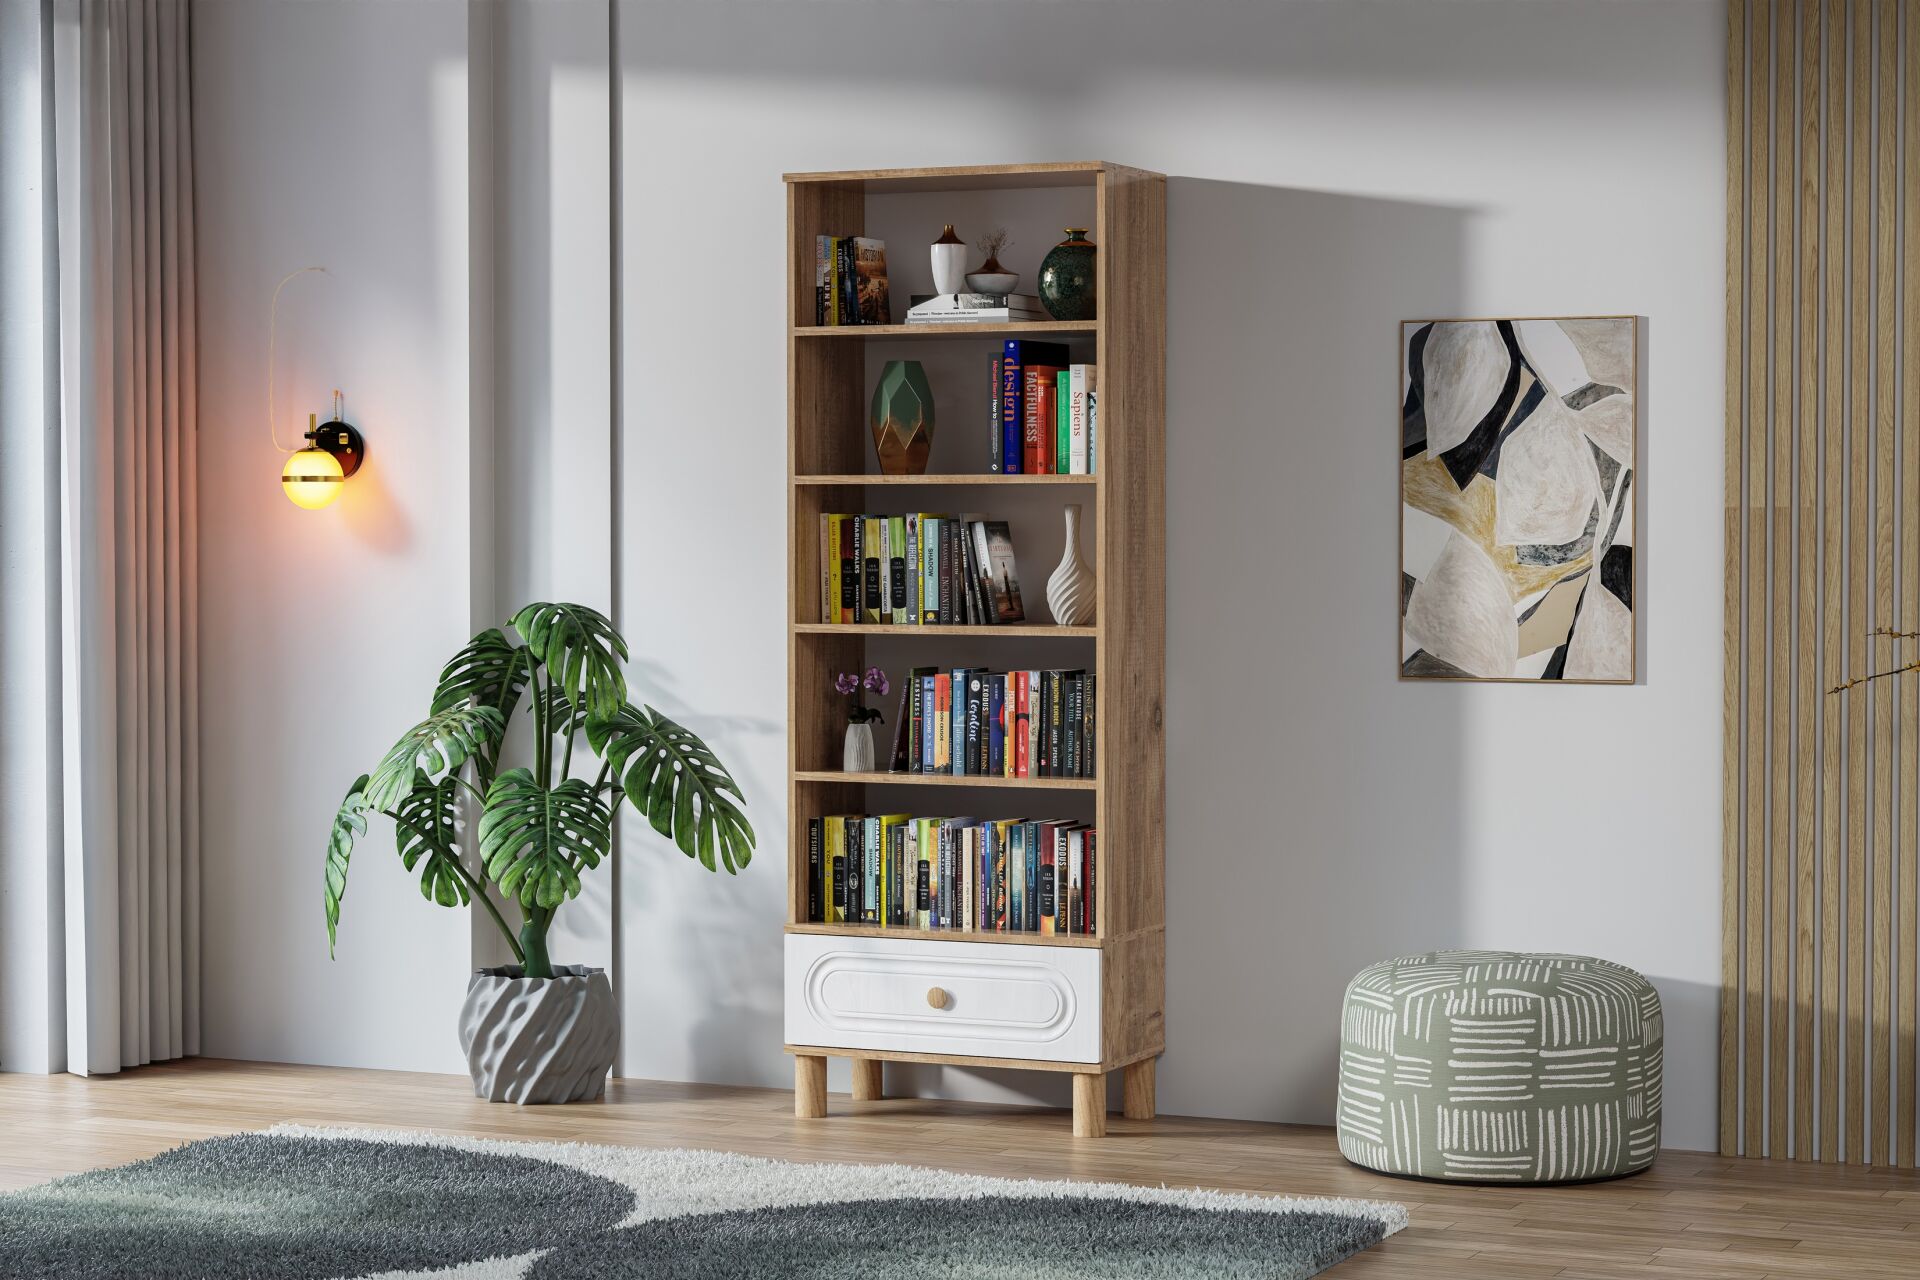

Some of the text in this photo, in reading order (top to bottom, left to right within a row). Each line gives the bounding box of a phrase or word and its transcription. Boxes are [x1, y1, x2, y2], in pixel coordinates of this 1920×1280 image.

[1004, 358, 1020, 421] design
[1027, 372, 1037, 442] FACTFULNESS
[1071, 392, 1084, 436] Sapiens
[908, 545, 917, 569] REFLECTION
[969, 700, 980, 743] Coraline
